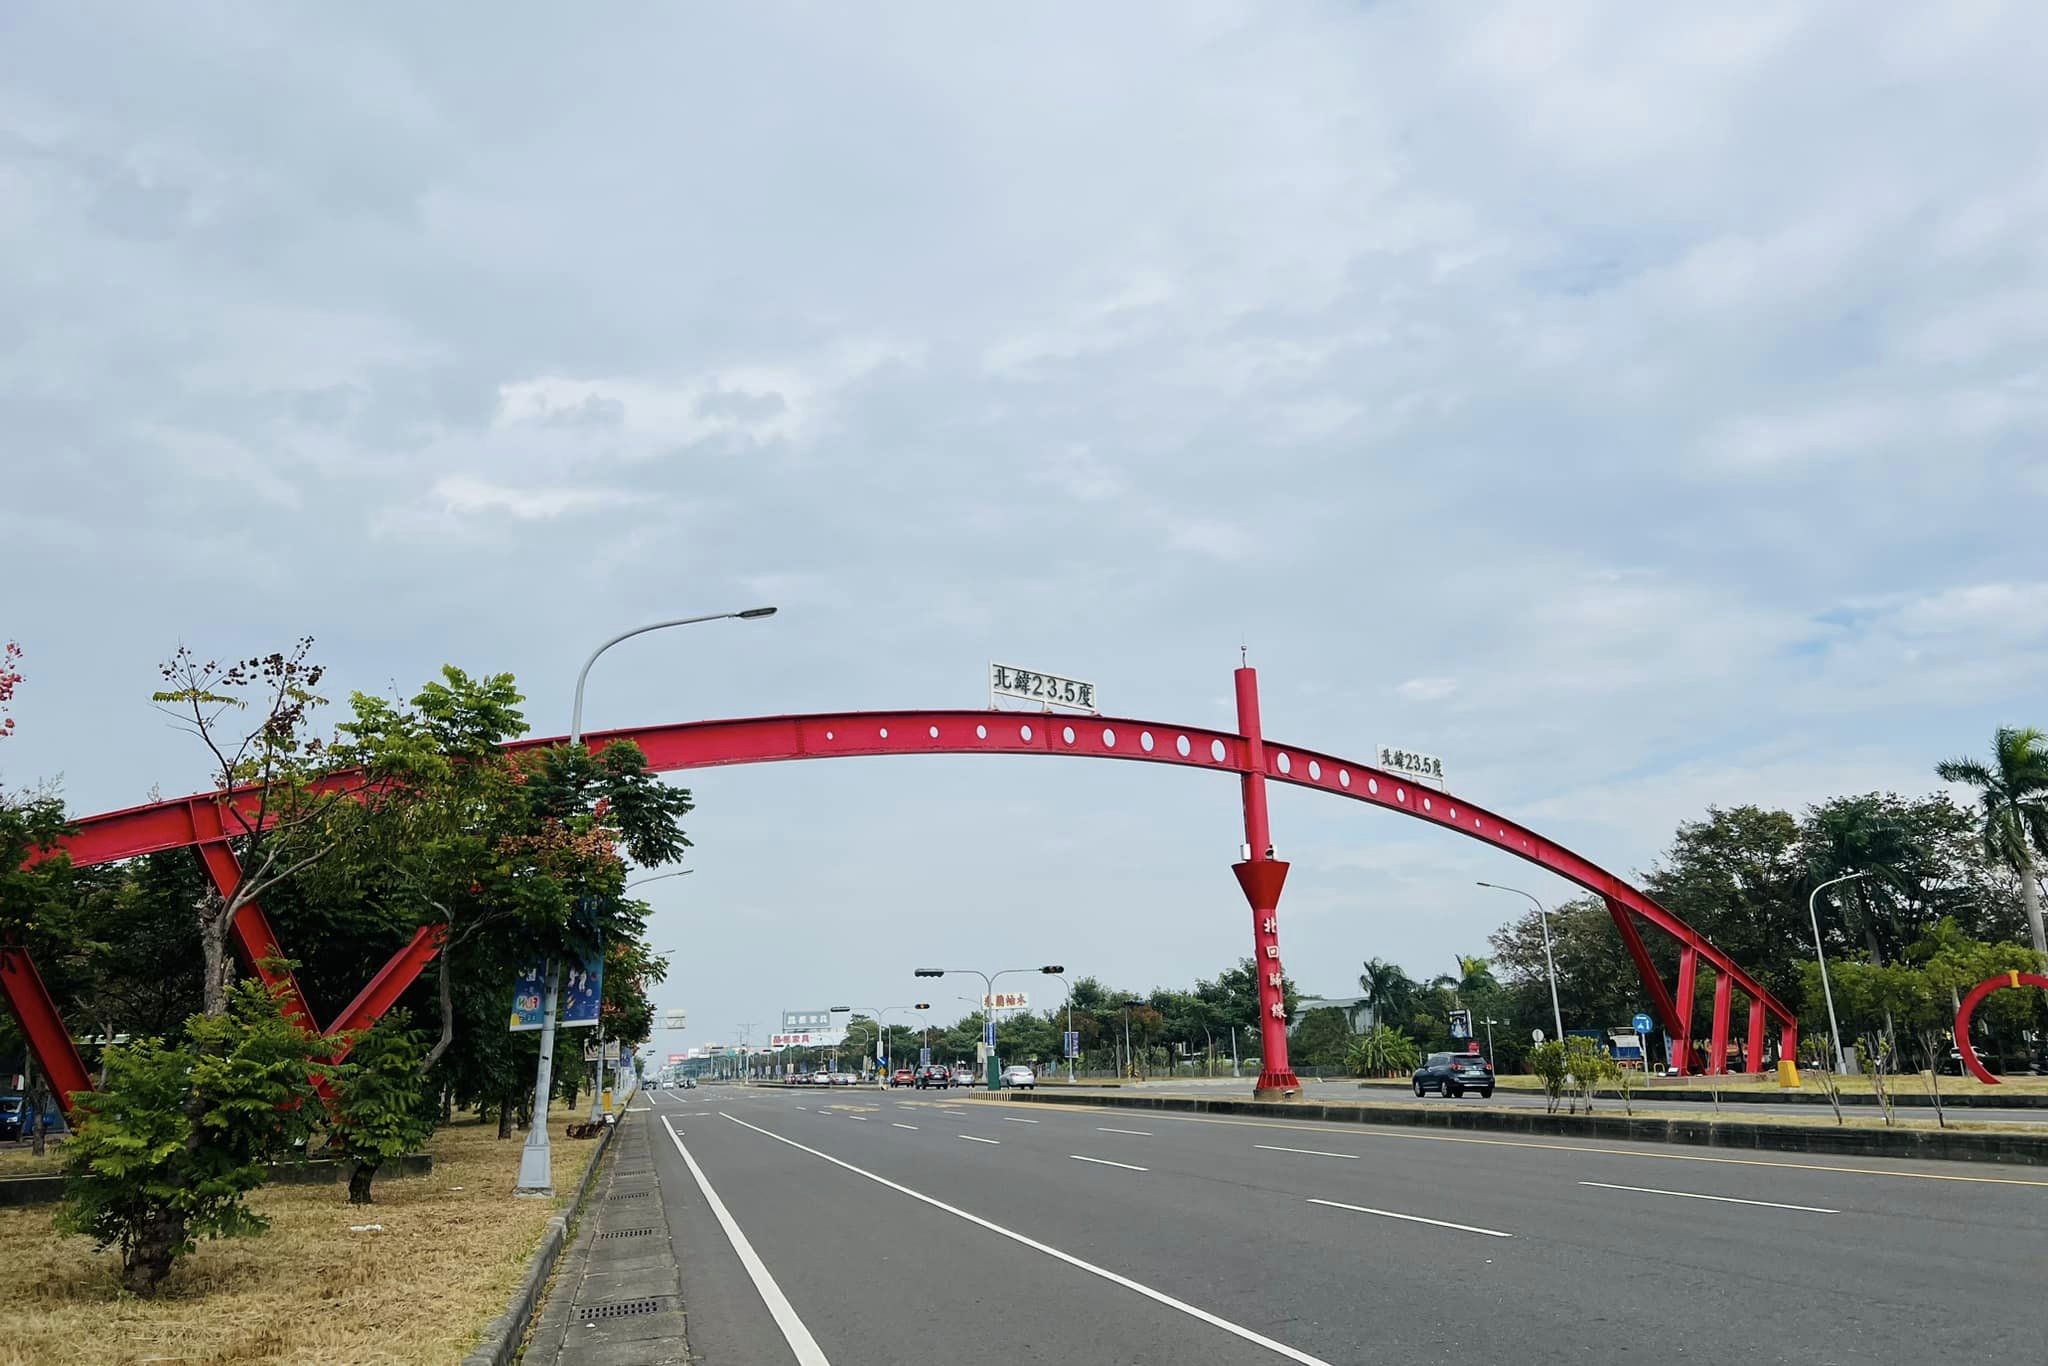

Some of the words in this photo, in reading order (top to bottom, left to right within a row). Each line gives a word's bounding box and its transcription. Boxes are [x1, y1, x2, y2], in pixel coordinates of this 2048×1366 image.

[993, 664, 1093, 709] 北緯23.5度
[1380, 747, 1444, 777] 北緯23.5度
